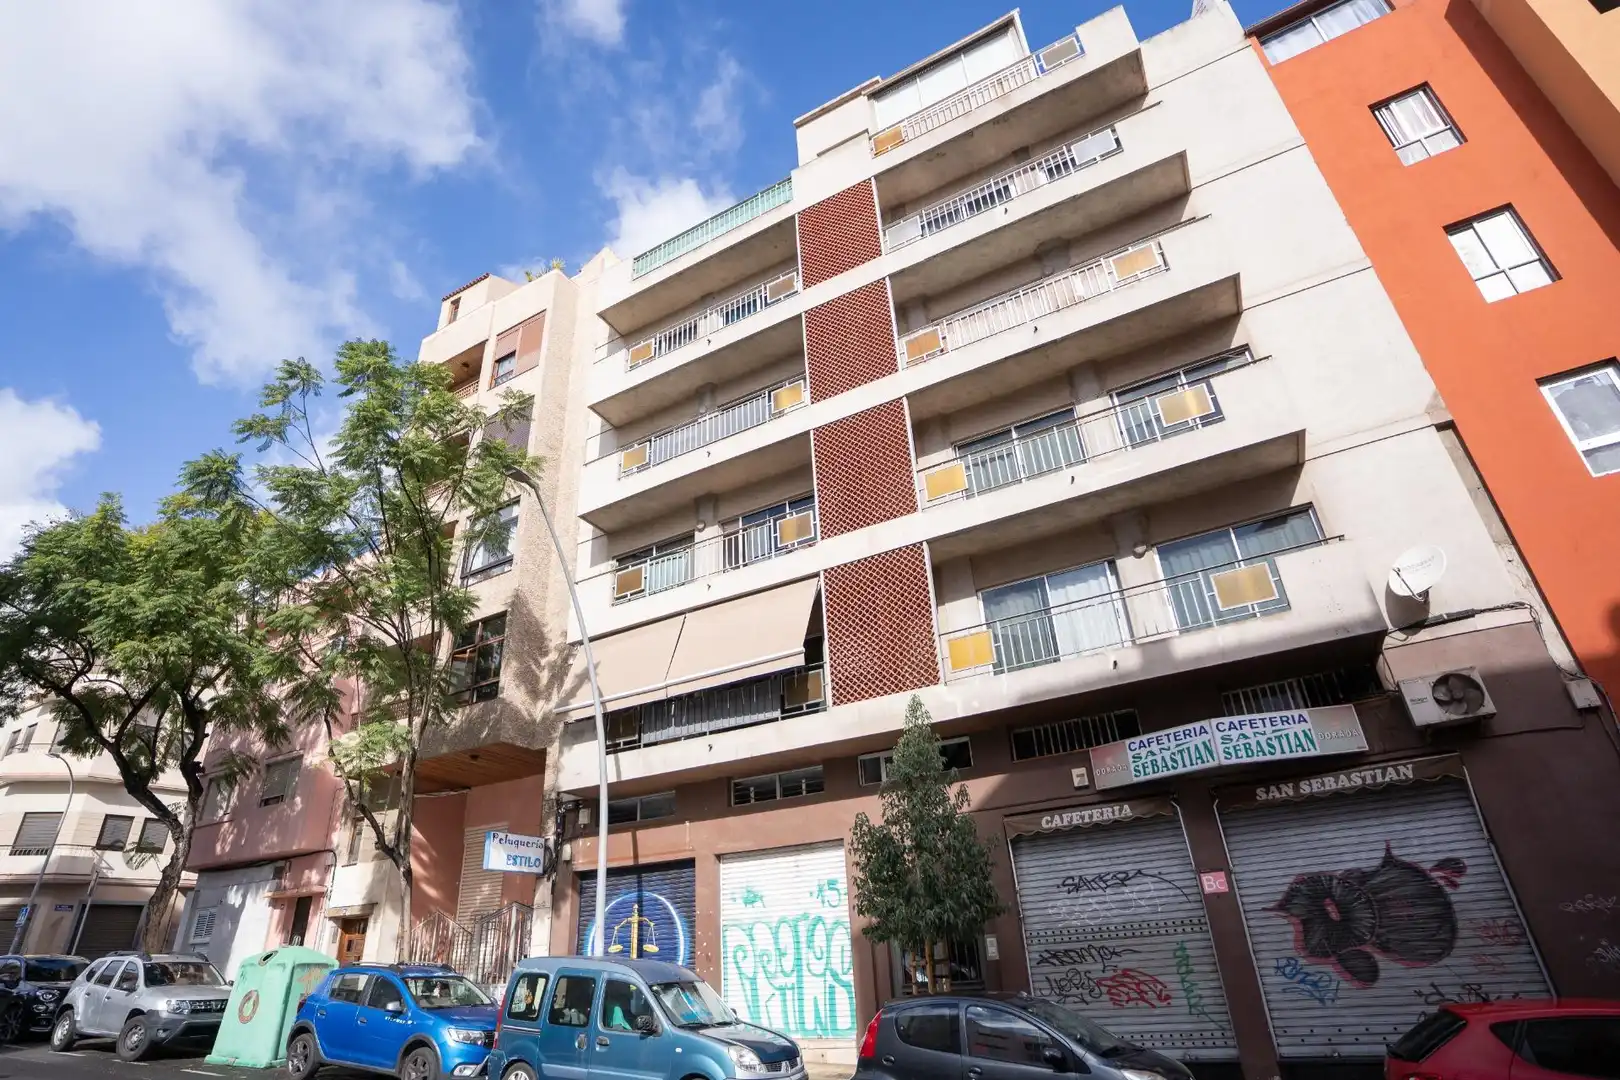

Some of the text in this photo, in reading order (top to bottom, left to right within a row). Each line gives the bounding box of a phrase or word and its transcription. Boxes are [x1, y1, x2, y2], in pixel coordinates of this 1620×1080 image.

[1215, 713, 1309, 733] CAFETERIA
[1127, 725, 1209, 752] CAFETERIA
[1220, 730, 1267, 745] SAN
[1223, 728, 1318, 760] SEBASTIAN
[1317, 728, 1361, 741] DORADA
[1131, 745, 1171, 764] SAN
[1133, 739, 1216, 778] SEBASTIAN
[1255, 764, 1414, 801] SAN SEBASTIAN
[1041, 804, 1133, 829] CAFETERIA
[506, 854, 541, 868] ESTILO
[1203, 875, 1226, 891] Bc
